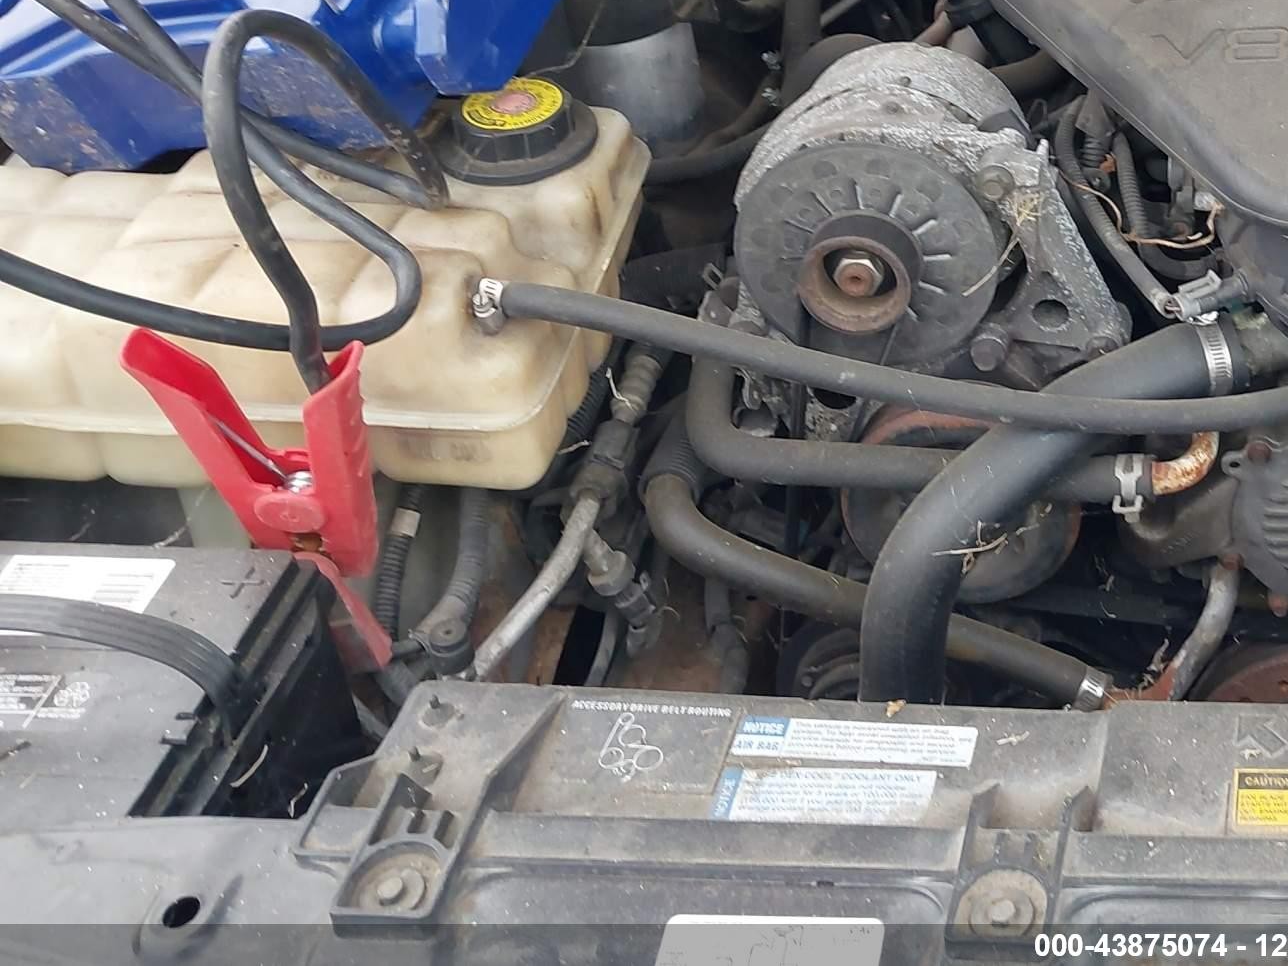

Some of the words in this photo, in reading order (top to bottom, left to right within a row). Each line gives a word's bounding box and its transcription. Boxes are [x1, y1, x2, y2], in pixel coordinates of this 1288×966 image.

[571, 700, 629, 713] ACCESSORY
[630, 703, 660, 714] DRIVE
[661, 705, 687, 715] BELT
[687, 706, 732, 718] ROUTING
[742, 721, 785, 735] NOTICE
[735, 739, 755, 749] AIR
